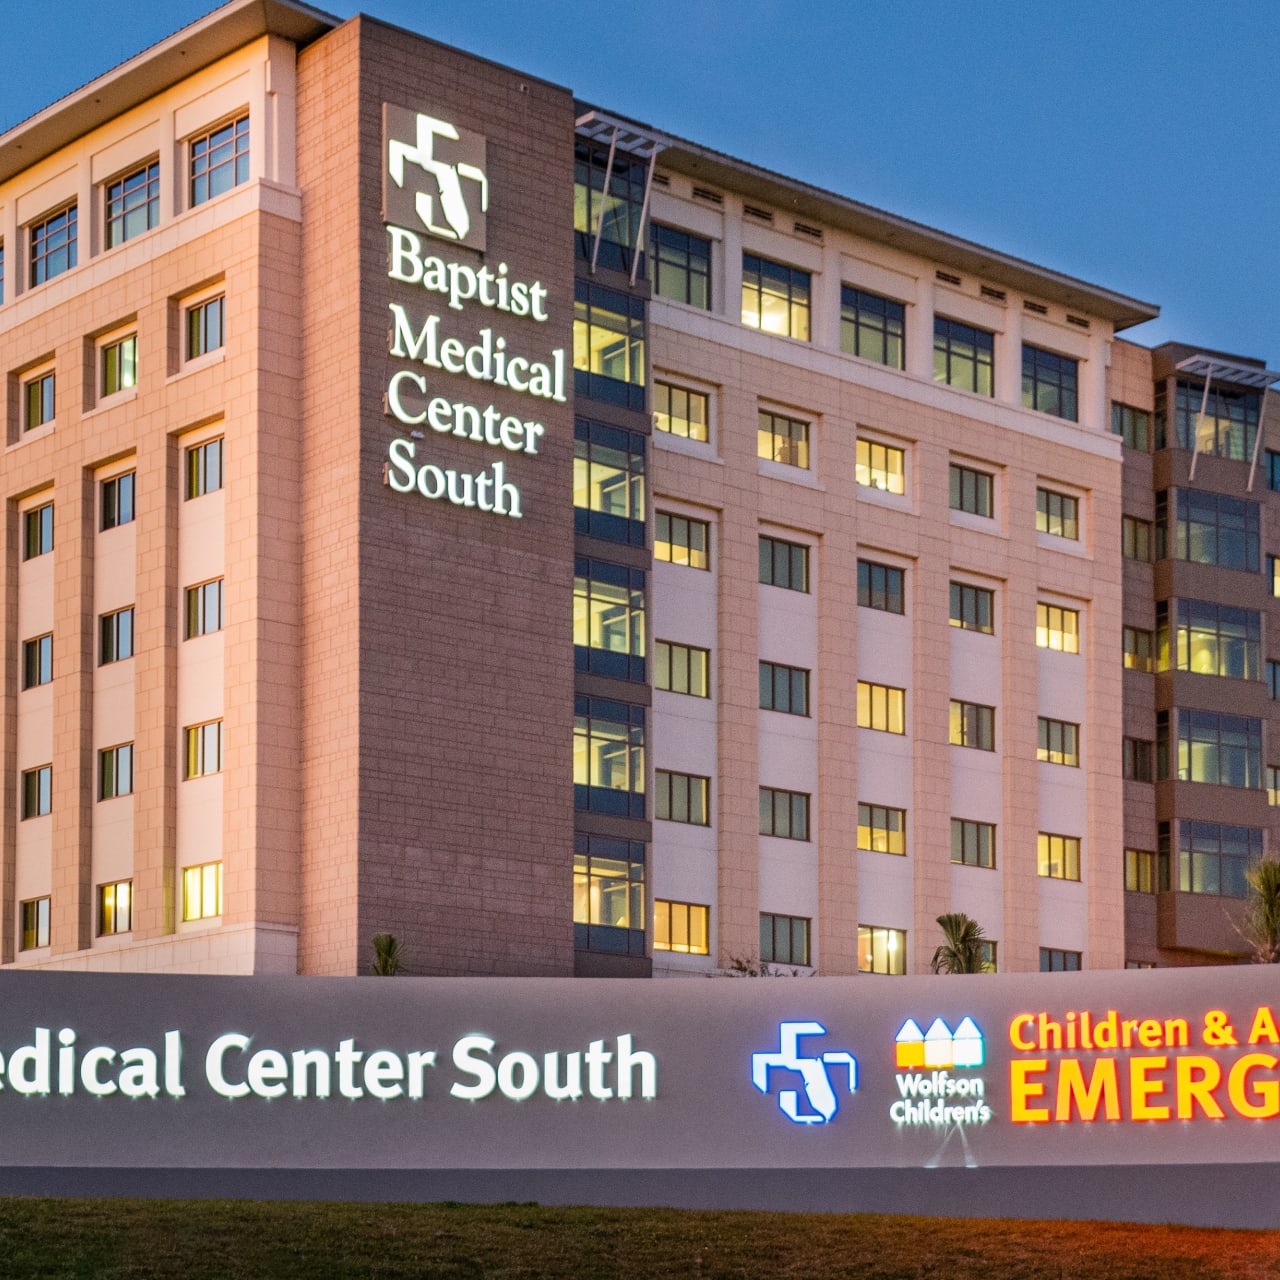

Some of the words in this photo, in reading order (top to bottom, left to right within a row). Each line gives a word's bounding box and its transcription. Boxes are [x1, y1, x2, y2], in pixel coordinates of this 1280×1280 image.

[386, 225, 548, 322] Baptist
[388, 303, 567, 402] Medical
[387, 370, 545, 454] Center
[388, 438, 523, 518] South
[204, 1034, 435, 1099] Center
[449, 1034, 658, 1100] South
[1008, 1011, 1191, 1051] Children
[1202, 1010, 1234, 1046] &
[889, 1099, 992, 1125] Children's
[895, 1071, 985, 1097] Wolfson
